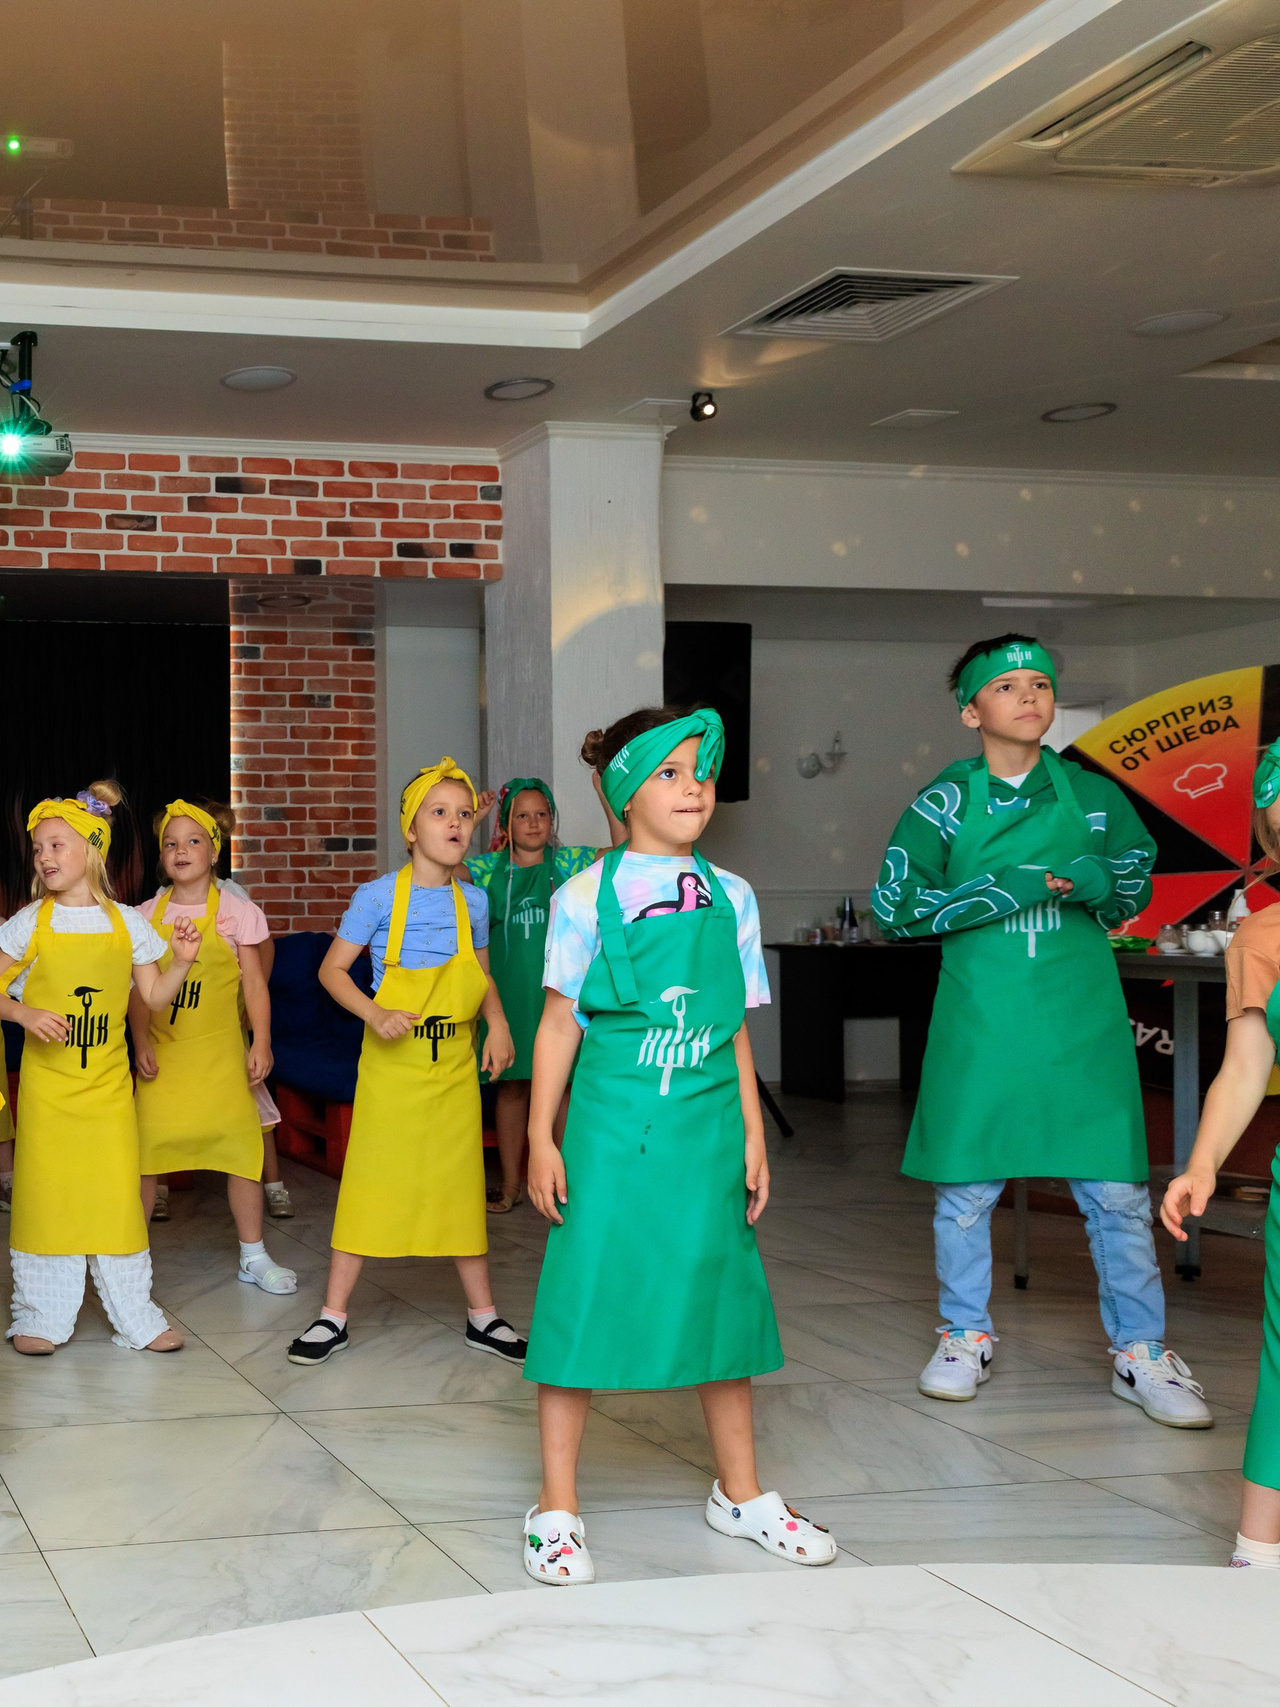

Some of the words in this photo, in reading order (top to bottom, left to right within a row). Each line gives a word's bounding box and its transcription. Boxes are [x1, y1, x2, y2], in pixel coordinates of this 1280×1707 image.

[1109, 695, 1234, 754] СЮРПРИЗ
[1121, 746, 1150, 771] ОТ
[1155, 715, 1240, 753] ШЕФА
